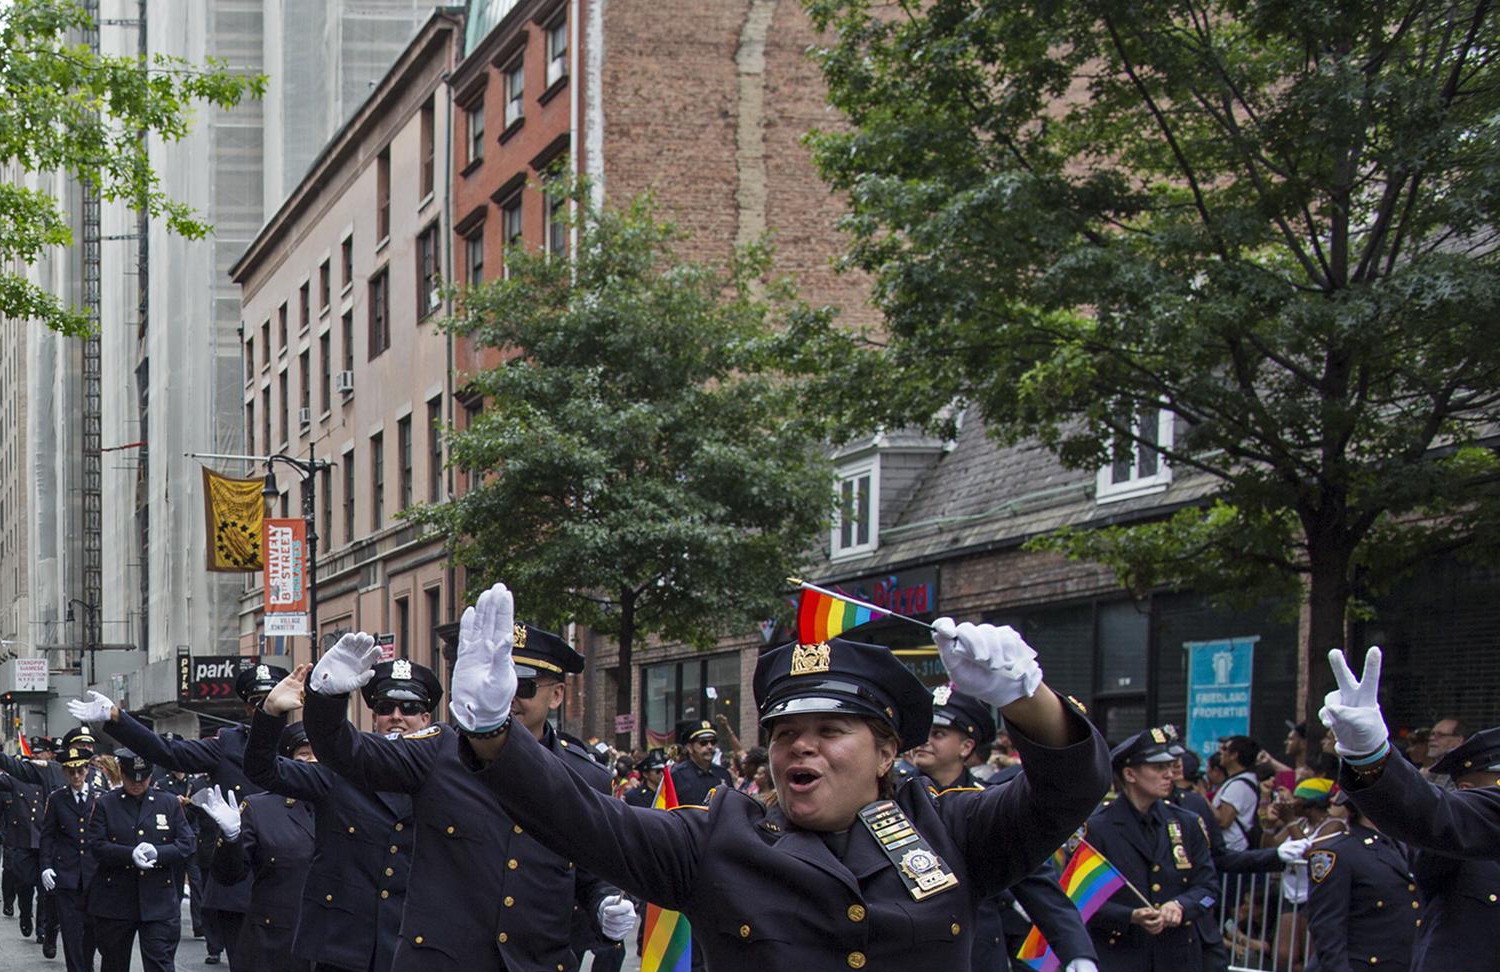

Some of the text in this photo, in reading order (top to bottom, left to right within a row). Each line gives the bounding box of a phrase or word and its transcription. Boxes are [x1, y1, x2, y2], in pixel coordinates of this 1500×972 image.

[281, 529, 291, 579] STREET
[181, 658, 189, 690] park
[196, 659, 235, 682] park
